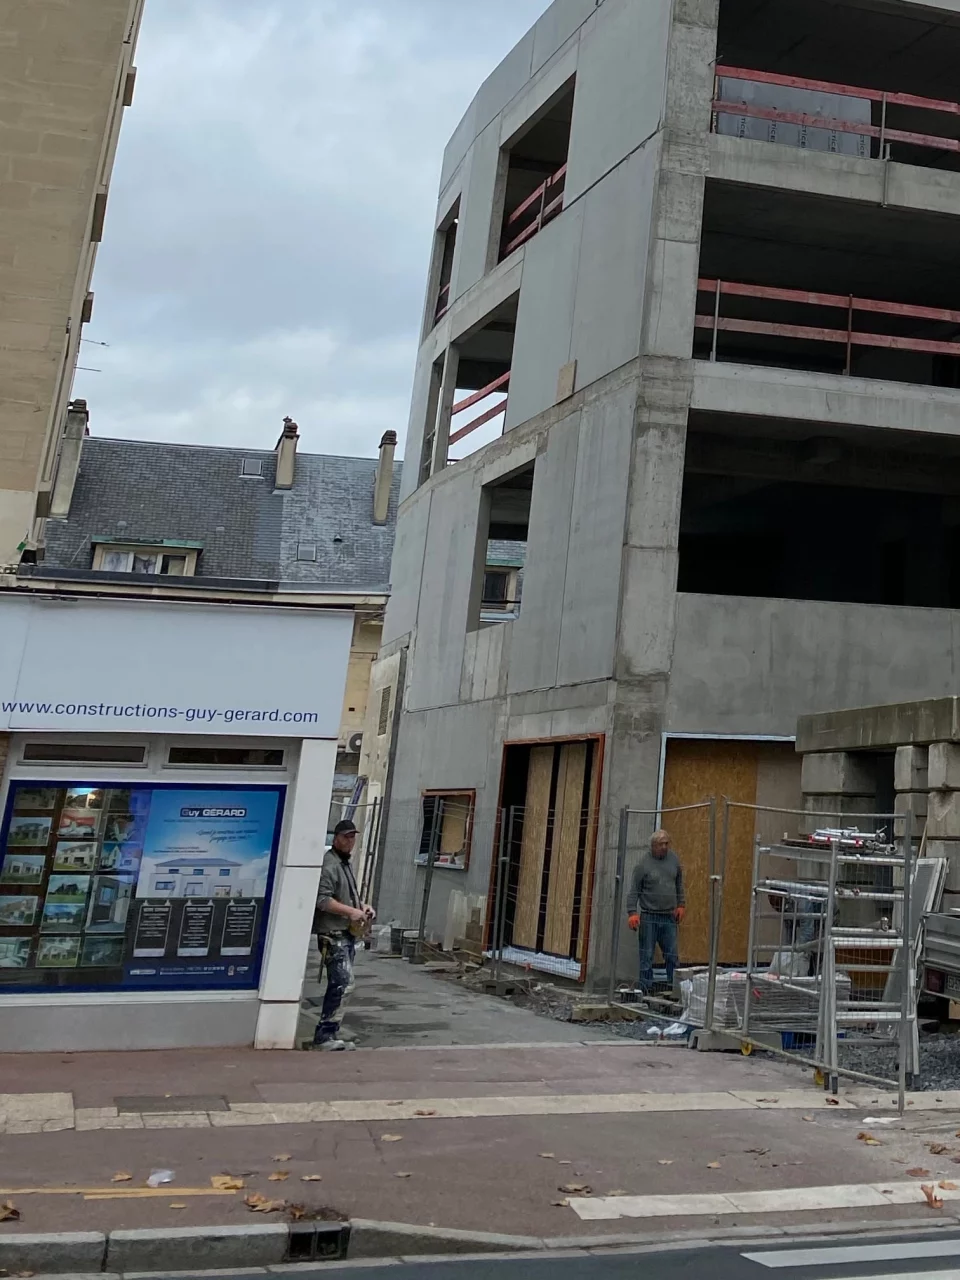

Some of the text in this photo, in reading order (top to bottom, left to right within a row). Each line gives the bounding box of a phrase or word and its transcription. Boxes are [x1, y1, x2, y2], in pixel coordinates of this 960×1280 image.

[1, 701, 318, 723] www.constructions-guy-gerard.com
[181, 808, 246, 818] Guy GÉRARD
